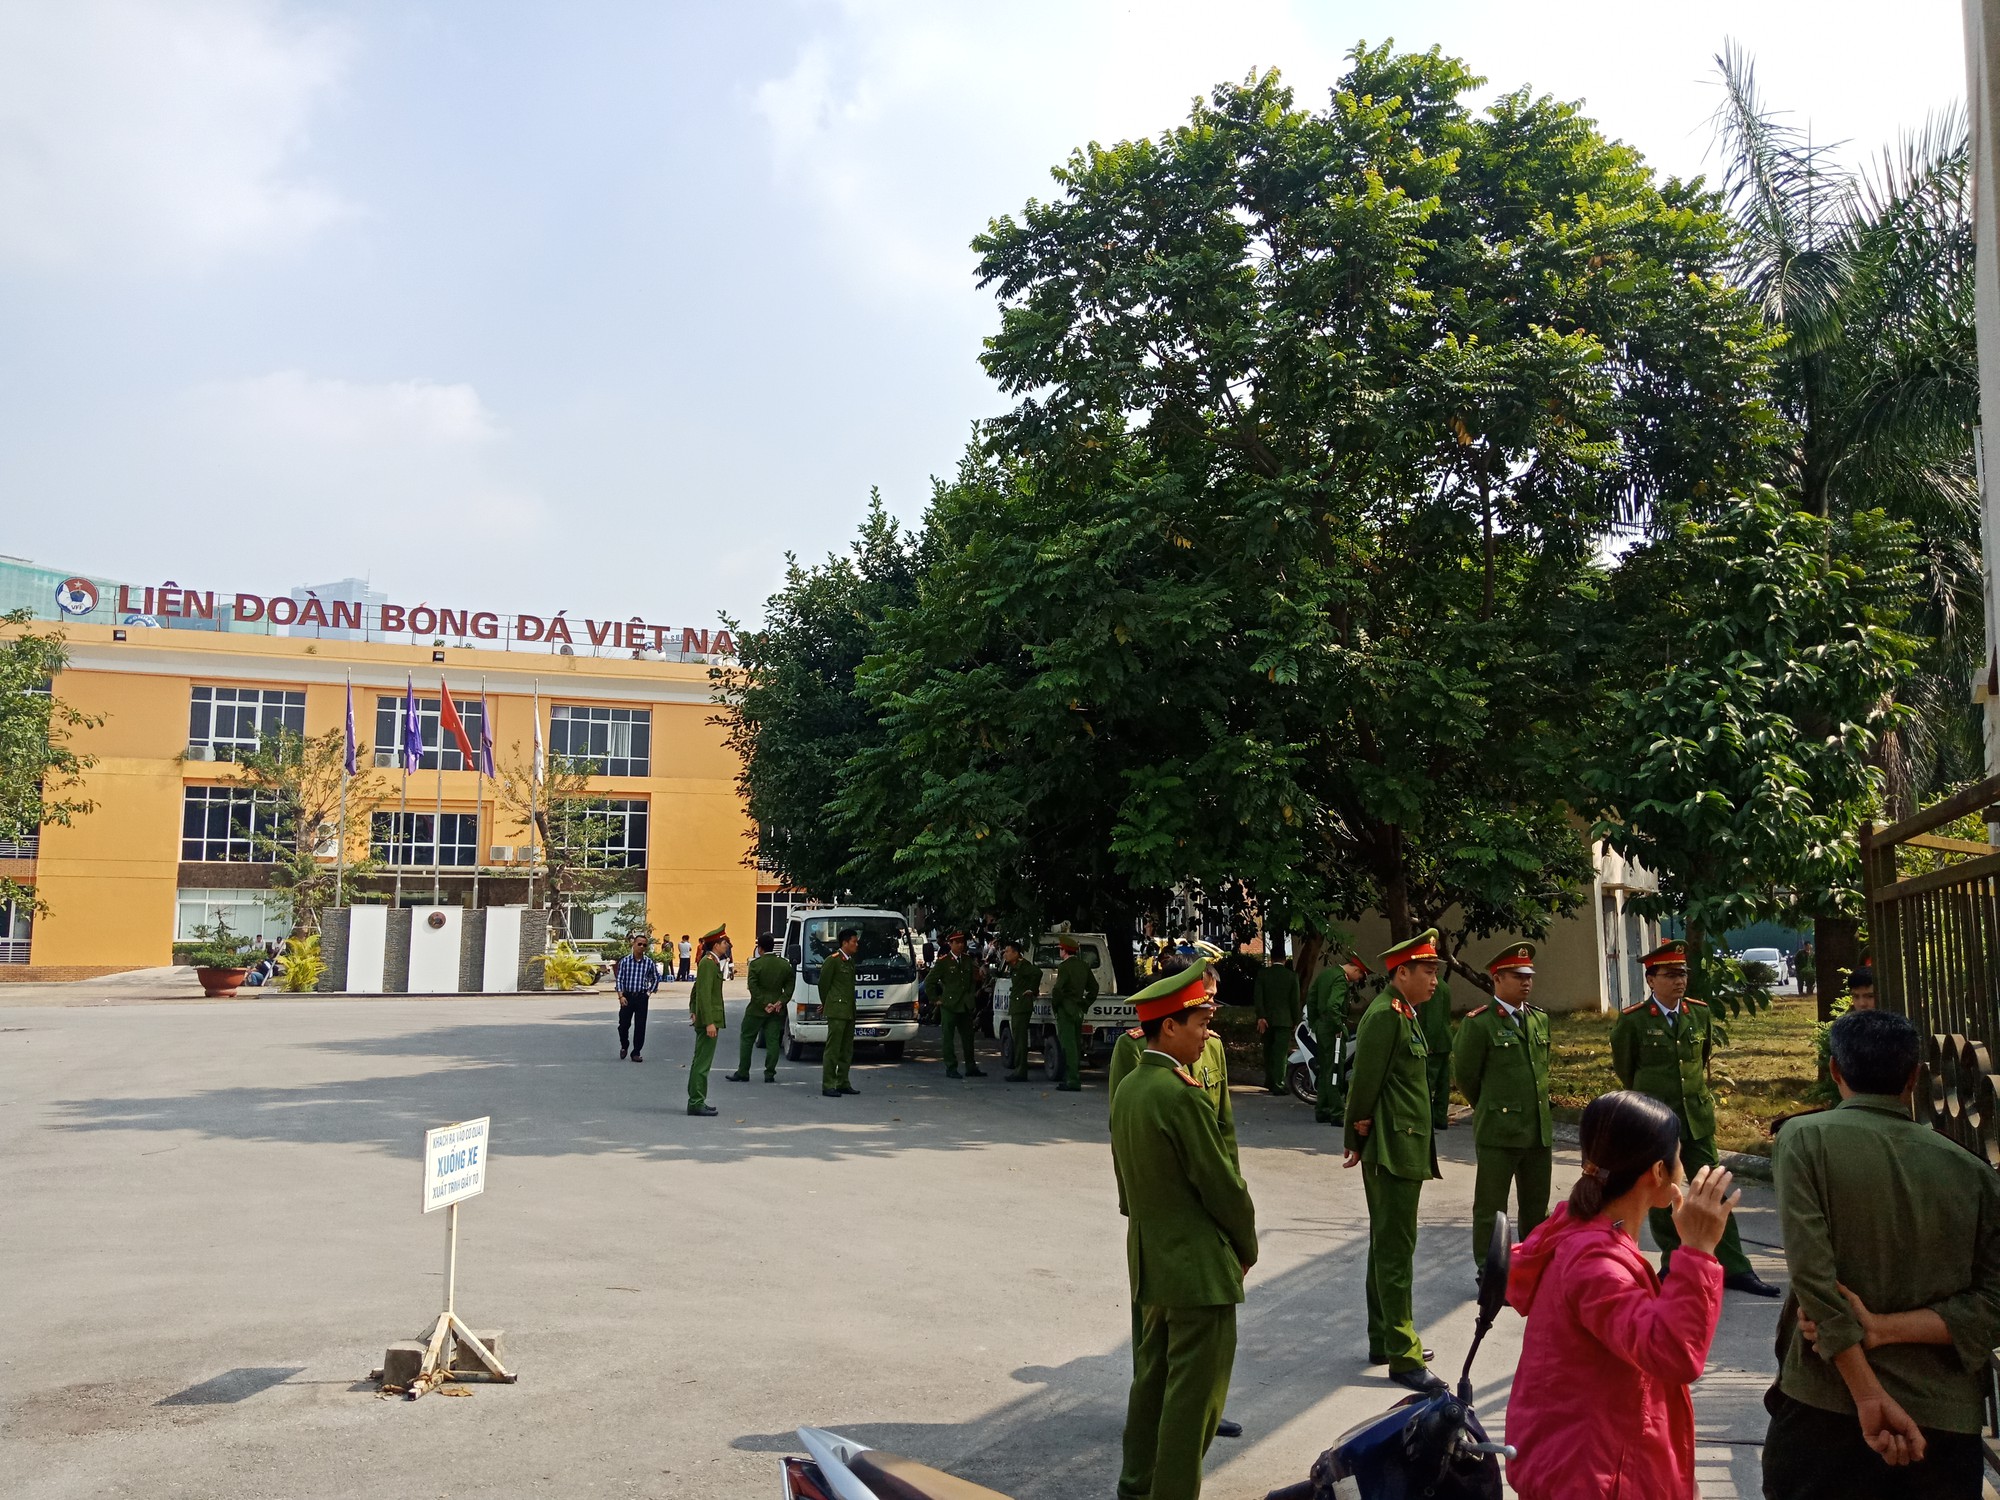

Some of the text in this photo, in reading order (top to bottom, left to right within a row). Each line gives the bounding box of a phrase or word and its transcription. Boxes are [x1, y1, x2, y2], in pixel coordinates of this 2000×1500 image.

[118, 581, 738, 656] LIÊN ĐOÀN BÓNG ĐÁ VIỆT NA
[855, 989, 884, 999] LICE
[1033, 1005, 1051, 1015] OLICE
[437, 1144, 479, 1178] XUỐNG XE
